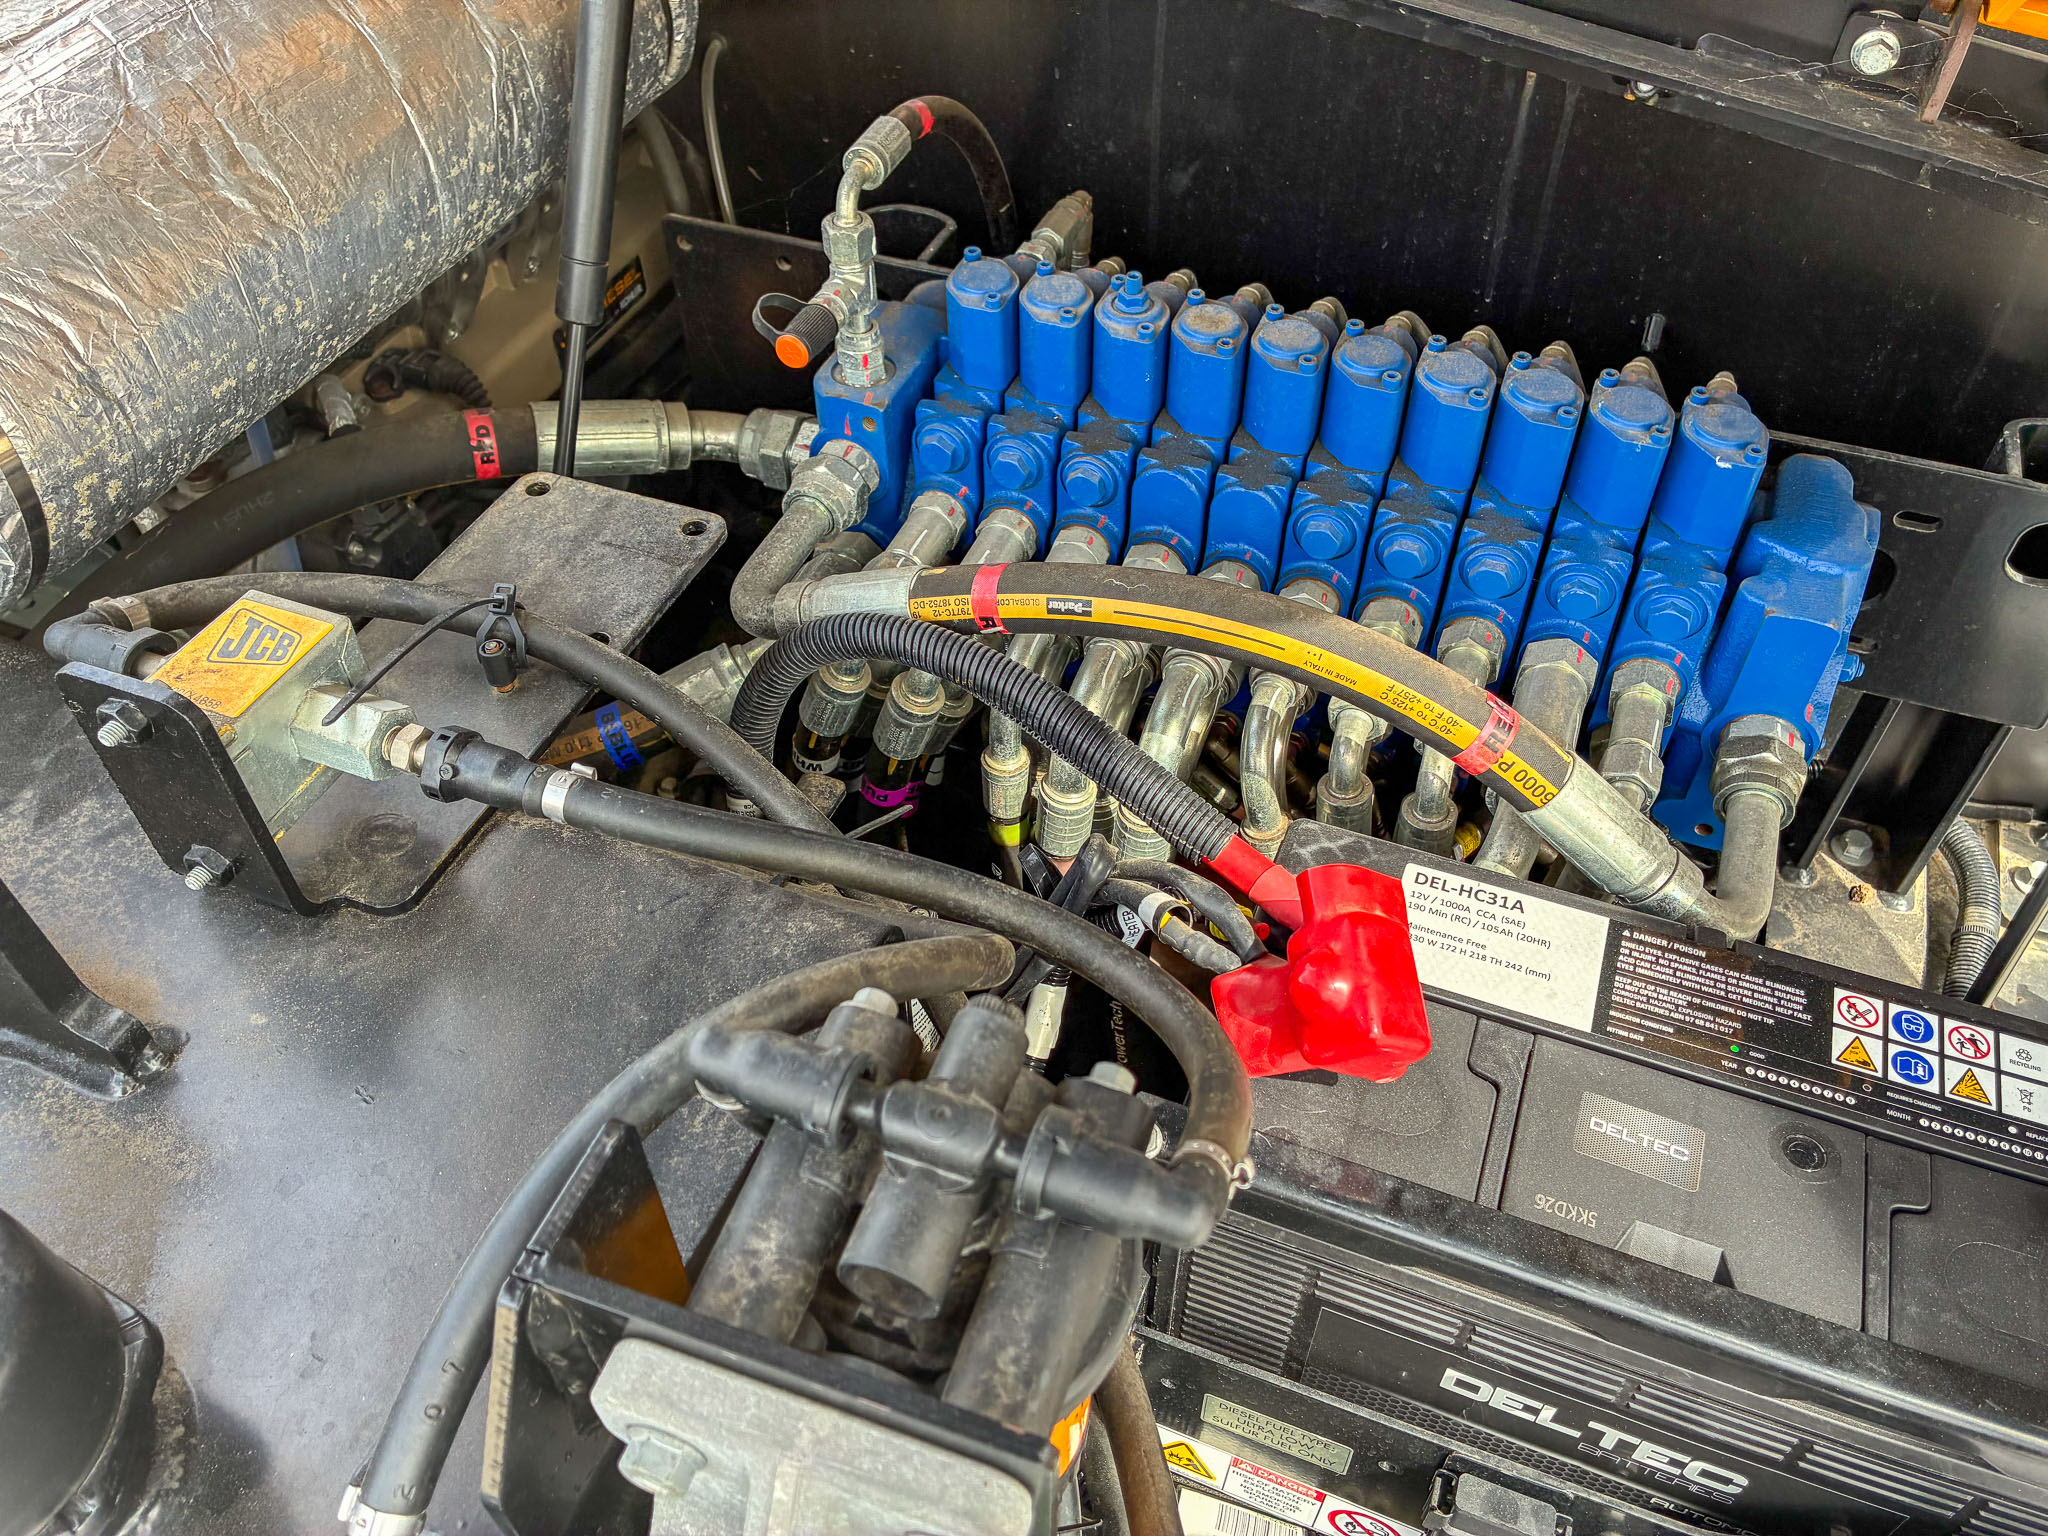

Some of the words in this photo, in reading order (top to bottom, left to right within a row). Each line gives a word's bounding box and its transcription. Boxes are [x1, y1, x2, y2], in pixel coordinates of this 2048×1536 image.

[914, 598, 952, 609] 18752-DC
[933, 607, 972, 618] 797TC-12
[954, 598, 970, 606] ISO
[1048, 600, 1083, 613] Parker
[216, 616, 296, 662] JCB
[1304, 660, 1324, 672] ITALY
[1334, 672, 1358, 686] MADE
[1416, 710, 1428, 720] TO
[1424, 702, 1435, 713] TO
[1414, 872, 1525, 914] DEL-HC31A
[1408, 901, 1426, 912] 190
[1428, 906, 1447, 919] Min
[1450, 913, 1471, 926] (RC)
[1481, 922, 1513, 938] 105Ah
[1516, 932, 1550, 949] (20HR)
[1410, 890, 1429, 902] 12V
[1440, 898, 1471, 914] 1000A
[1476, 908, 1496, 921] CCA
[1500, 915, 1525, 930] (SAE)
[1466, 938, 1486, 950] Free
[1633, 932, 1667, 947] DANGER
[1673, 943, 1705, 958] POISON
[1427, 938, 1437, 947] W
[1440, 942, 1456, 952] 172
[1459, 948, 1466, 956] H
[1469, 950, 1486, 961] 218
[1489, 956, 1502, 966] TH
[1504, 961, 1522, 972] 242
[1525, 966, 1551, 981] (mm)
[1621, 939, 1644, 951] SHIELD
[1646, 946, 1663, 956] EYES.
[1664, 952, 1699, 967] EXPLOSIVE
[1700, 962, 1723, 974] GASES
[1724, 969, 1738, 978] CAN
[1740, 973, 1762, 985] CAUSE
[1765, 980, 1805, 997] BLINDNESS
[1110, 1000, 1128, 1065] owerTech
[1720, 1059, 1737, 1069] YEAR
[2009, 1058, 2042, 1072] RECYCLING
[1886, 1108, 1912, 1122] MONTH
[1589, 1116, 1690, 1162] DELTEC
[1534, 1193, 1598, 1228] 5KKD26
[1212, 1415, 1259, 1437] SULFUR
[1264, 1434, 1293, 1451] FUEL
[1297, 1448, 1335, 1467] ONLY
[1219, 1402, 1261, 1423] DIESEL
[1265, 1420, 1296, 1436] FUEL
[1300, 1433, 1335, 1452] TYPE:
[1236, 1417, 1275, 1436] ULTRA
[1279, 1433, 1314, 1451] LOW
[1440, 1368, 1748, 1494] DELTEC
[1257, 1470, 1317, 1496] DANGER
[1578, 1442, 1735, 1505] BATTERIES
